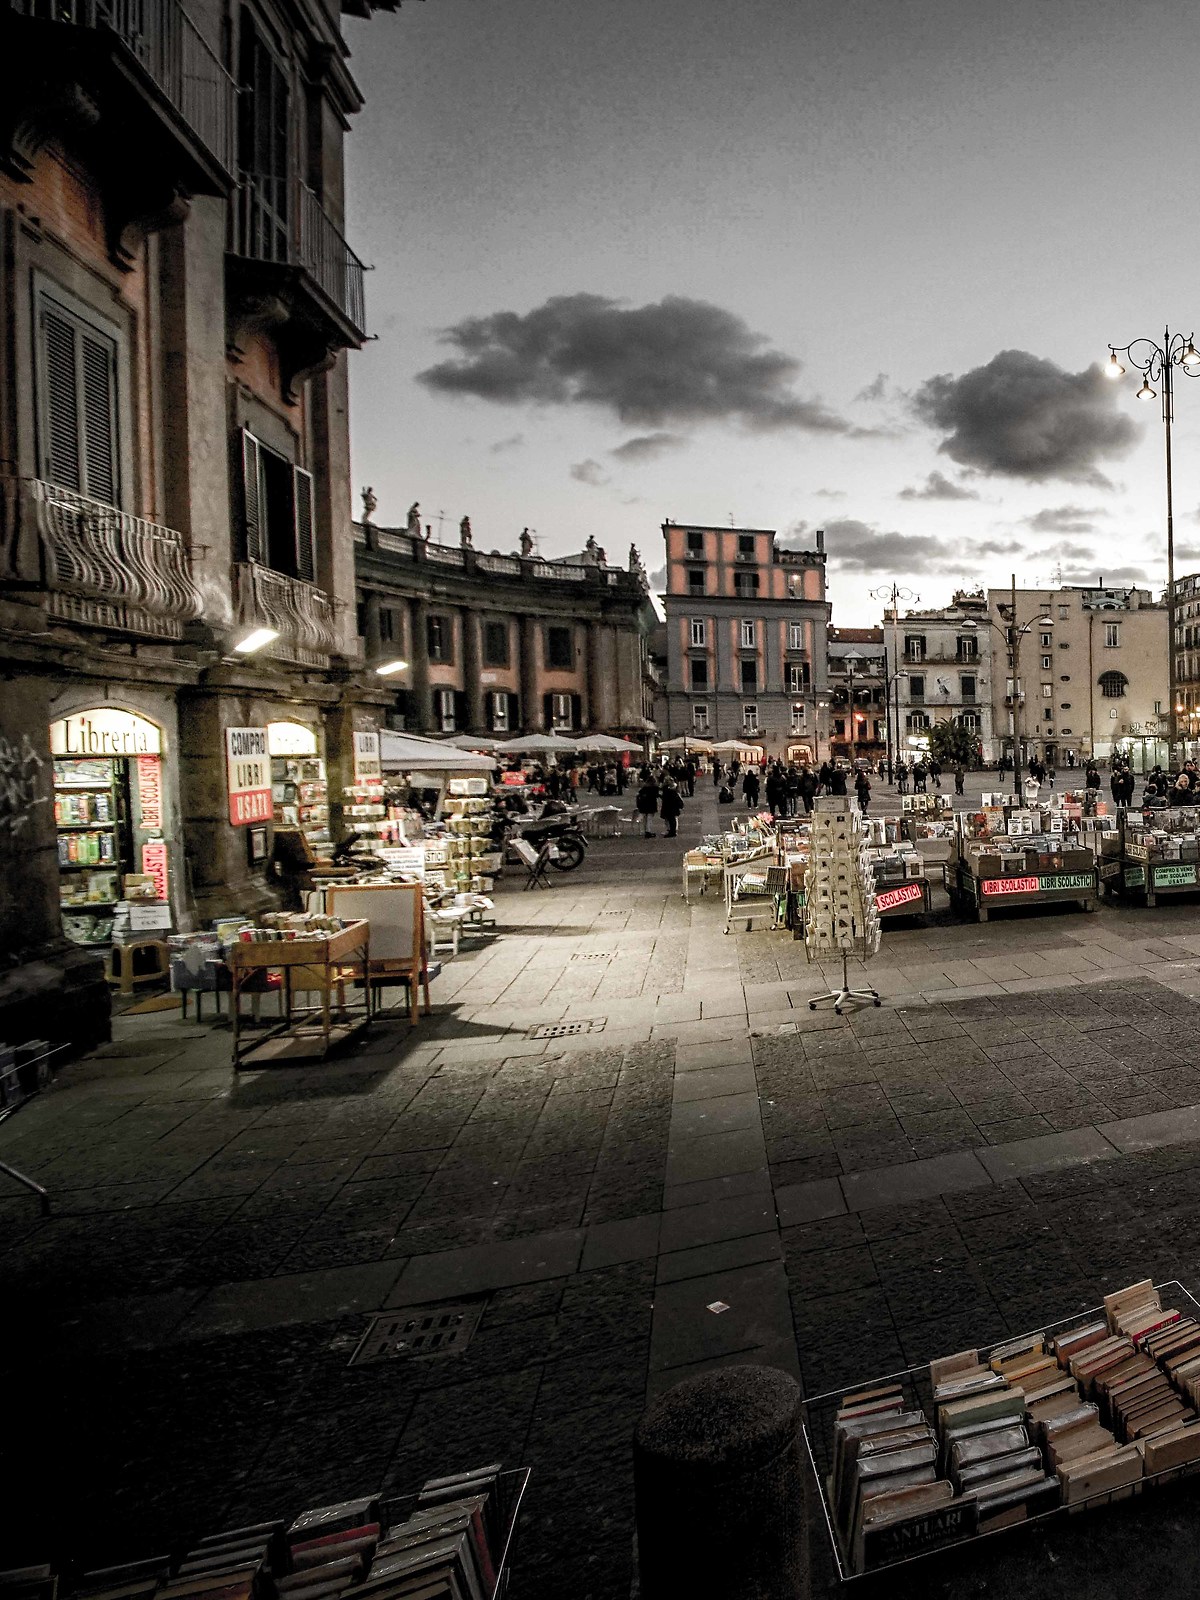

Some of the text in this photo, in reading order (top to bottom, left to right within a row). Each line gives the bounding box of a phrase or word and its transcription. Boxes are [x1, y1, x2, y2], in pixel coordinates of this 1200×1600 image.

[62, 717, 147, 753] Libreria
[231, 732, 265, 755] COMPRO
[237, 763, 264, 788] LIBRI
[140, 754, 160, 828] LIBRI SCOLASTICI
[237, 793, 268, 820] USATI
[983, 880, 1000, 894] LIBRI
[1001, 878, 1037, 892] SCOLASTICI
[1041, 874, 1092, 889] LIBRI SCOLASTICI
[880, 884, 920, 908] SCOLASTICI
